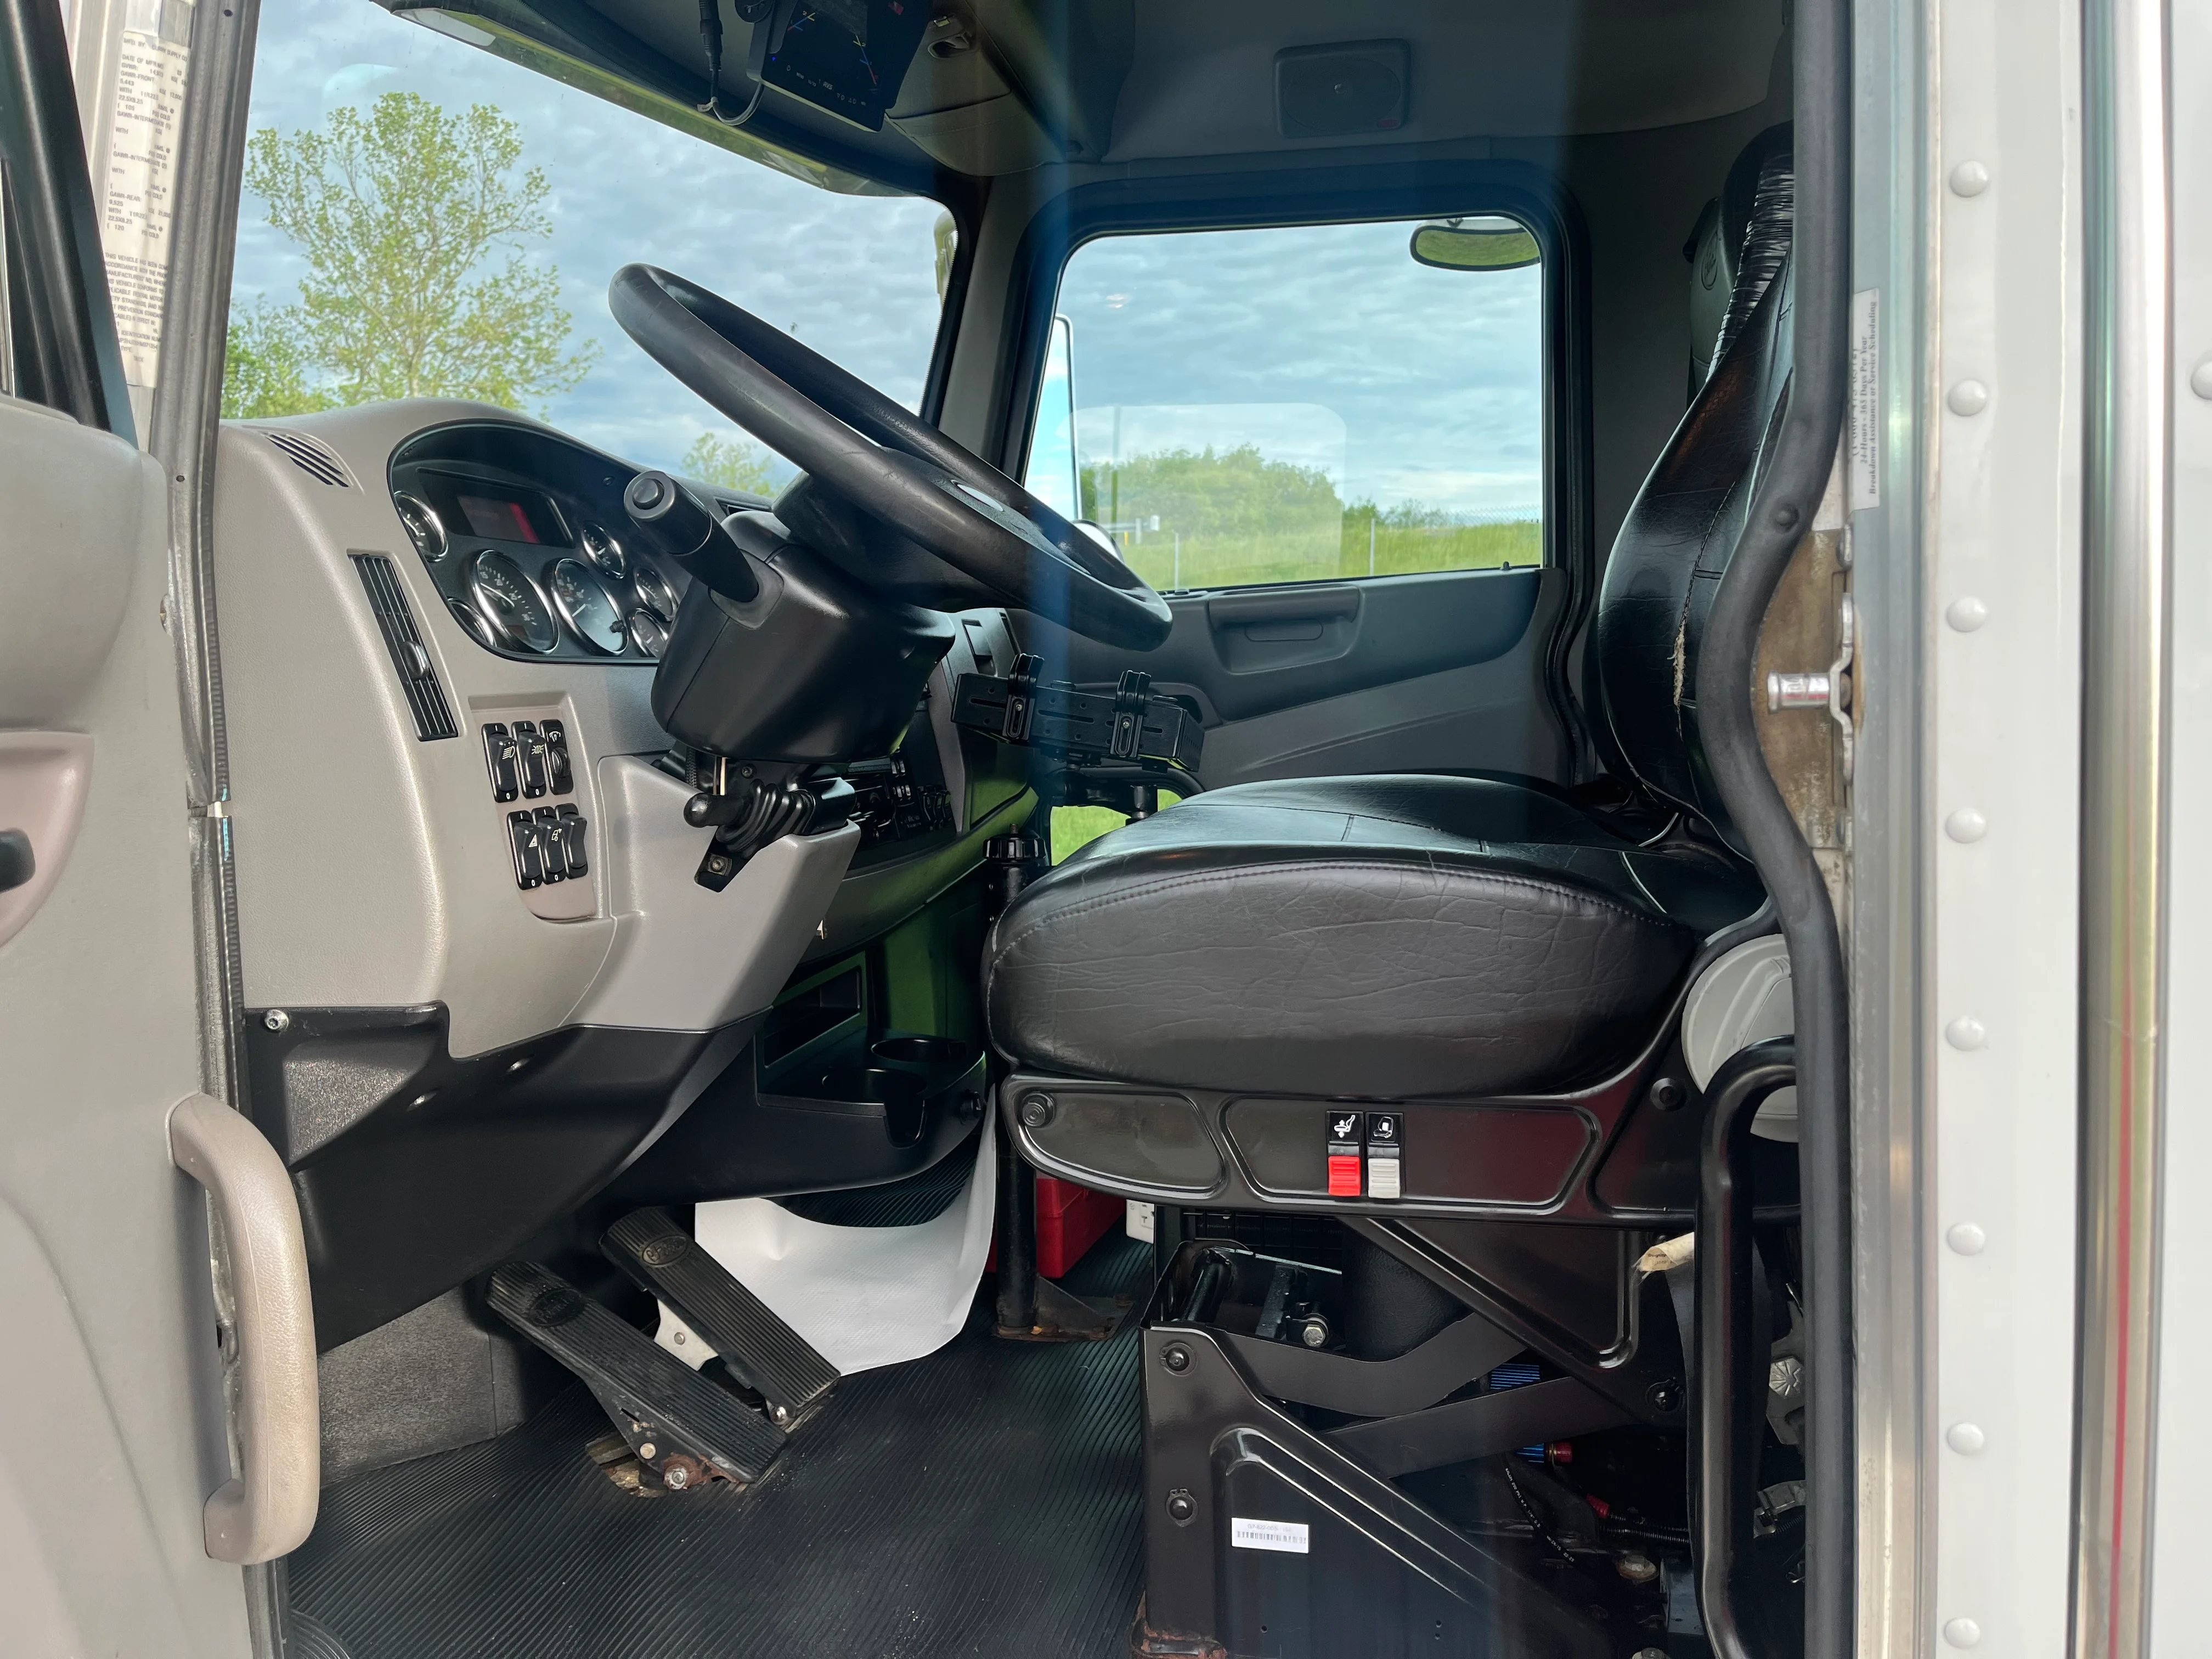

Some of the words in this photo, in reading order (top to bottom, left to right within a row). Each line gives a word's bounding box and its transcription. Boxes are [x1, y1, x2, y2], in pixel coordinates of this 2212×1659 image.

[115, 126, 128, 134] WITH
[111, 167, 125, 175] WITH
[1867, 302, 1877, 350] Scheduling
[1867, 353, 1876, 384] Service
[1870, 387, 1876, 397] or
